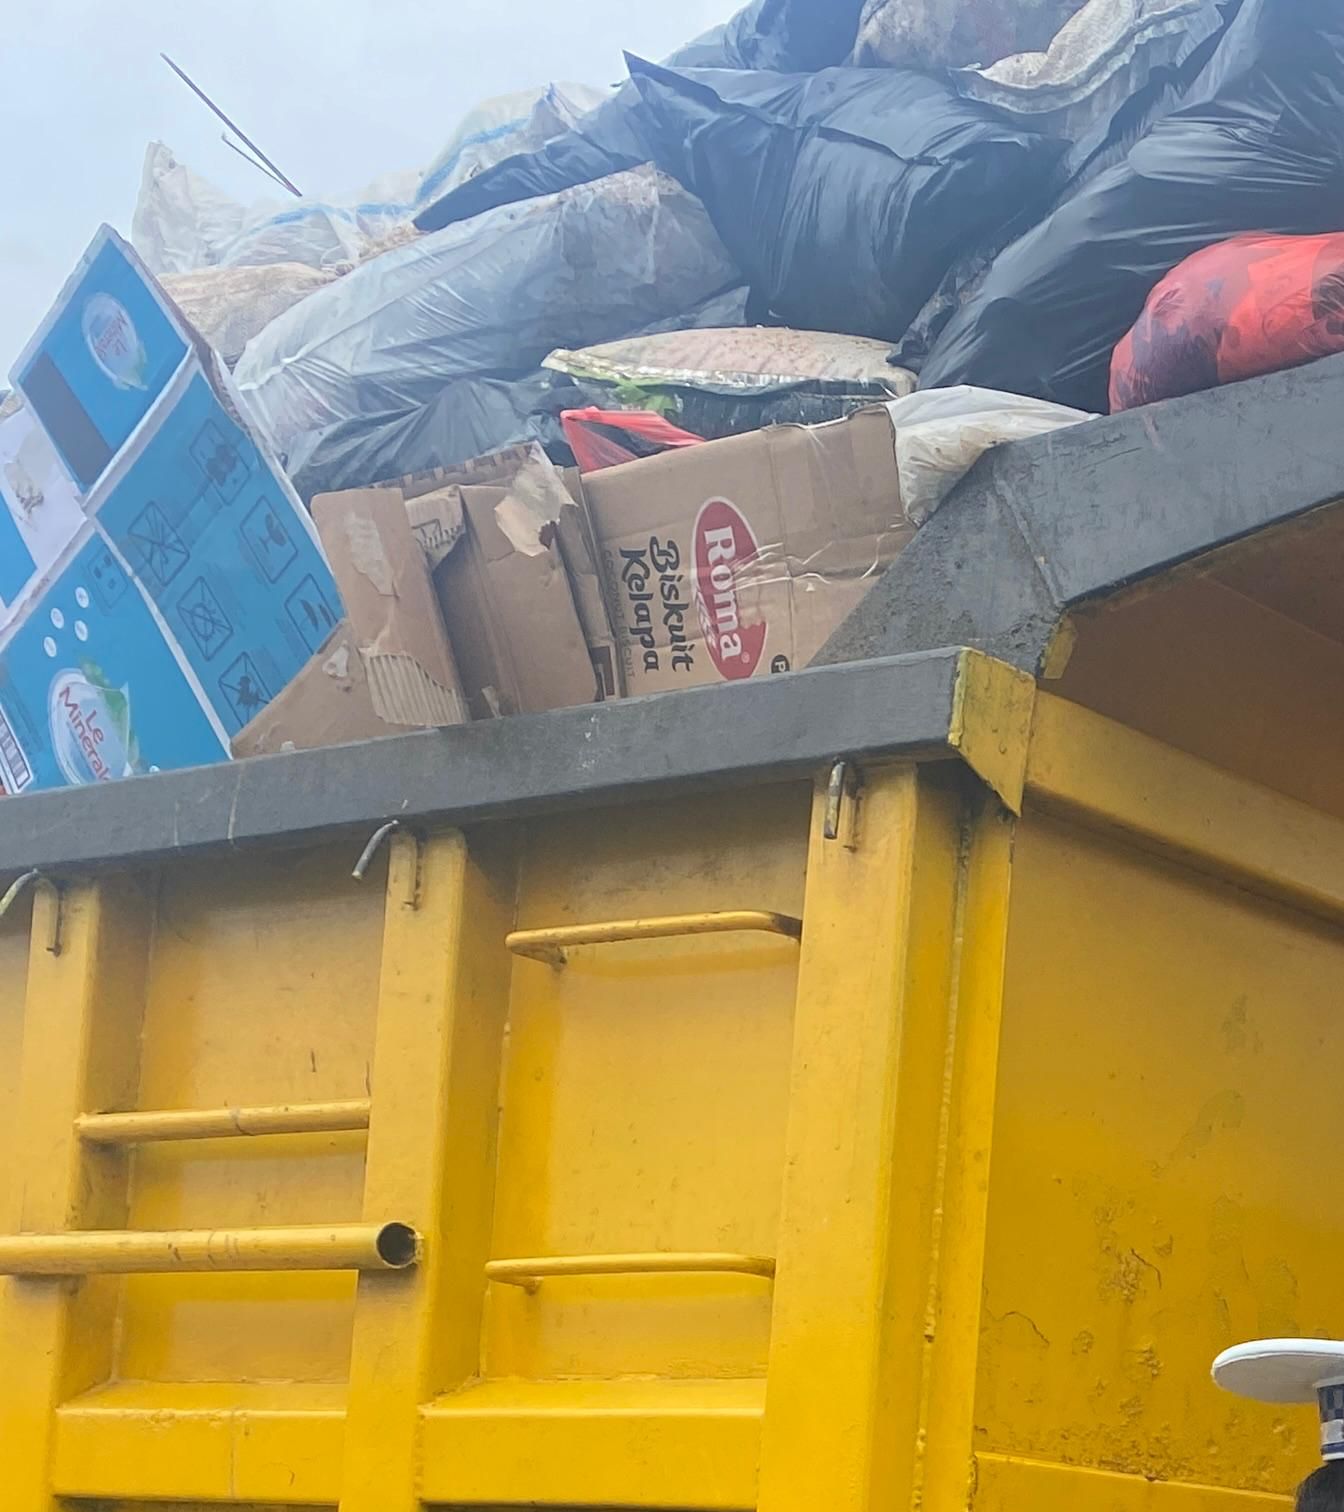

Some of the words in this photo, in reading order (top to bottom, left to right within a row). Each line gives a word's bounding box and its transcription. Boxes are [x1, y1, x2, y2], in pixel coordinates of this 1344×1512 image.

[619, 546, 660, 674] Kelapa
[649, 536, 694, 673] Biskuit
[703, 525, 743, 661] Roma
[85, 709, 105, 745] Le
